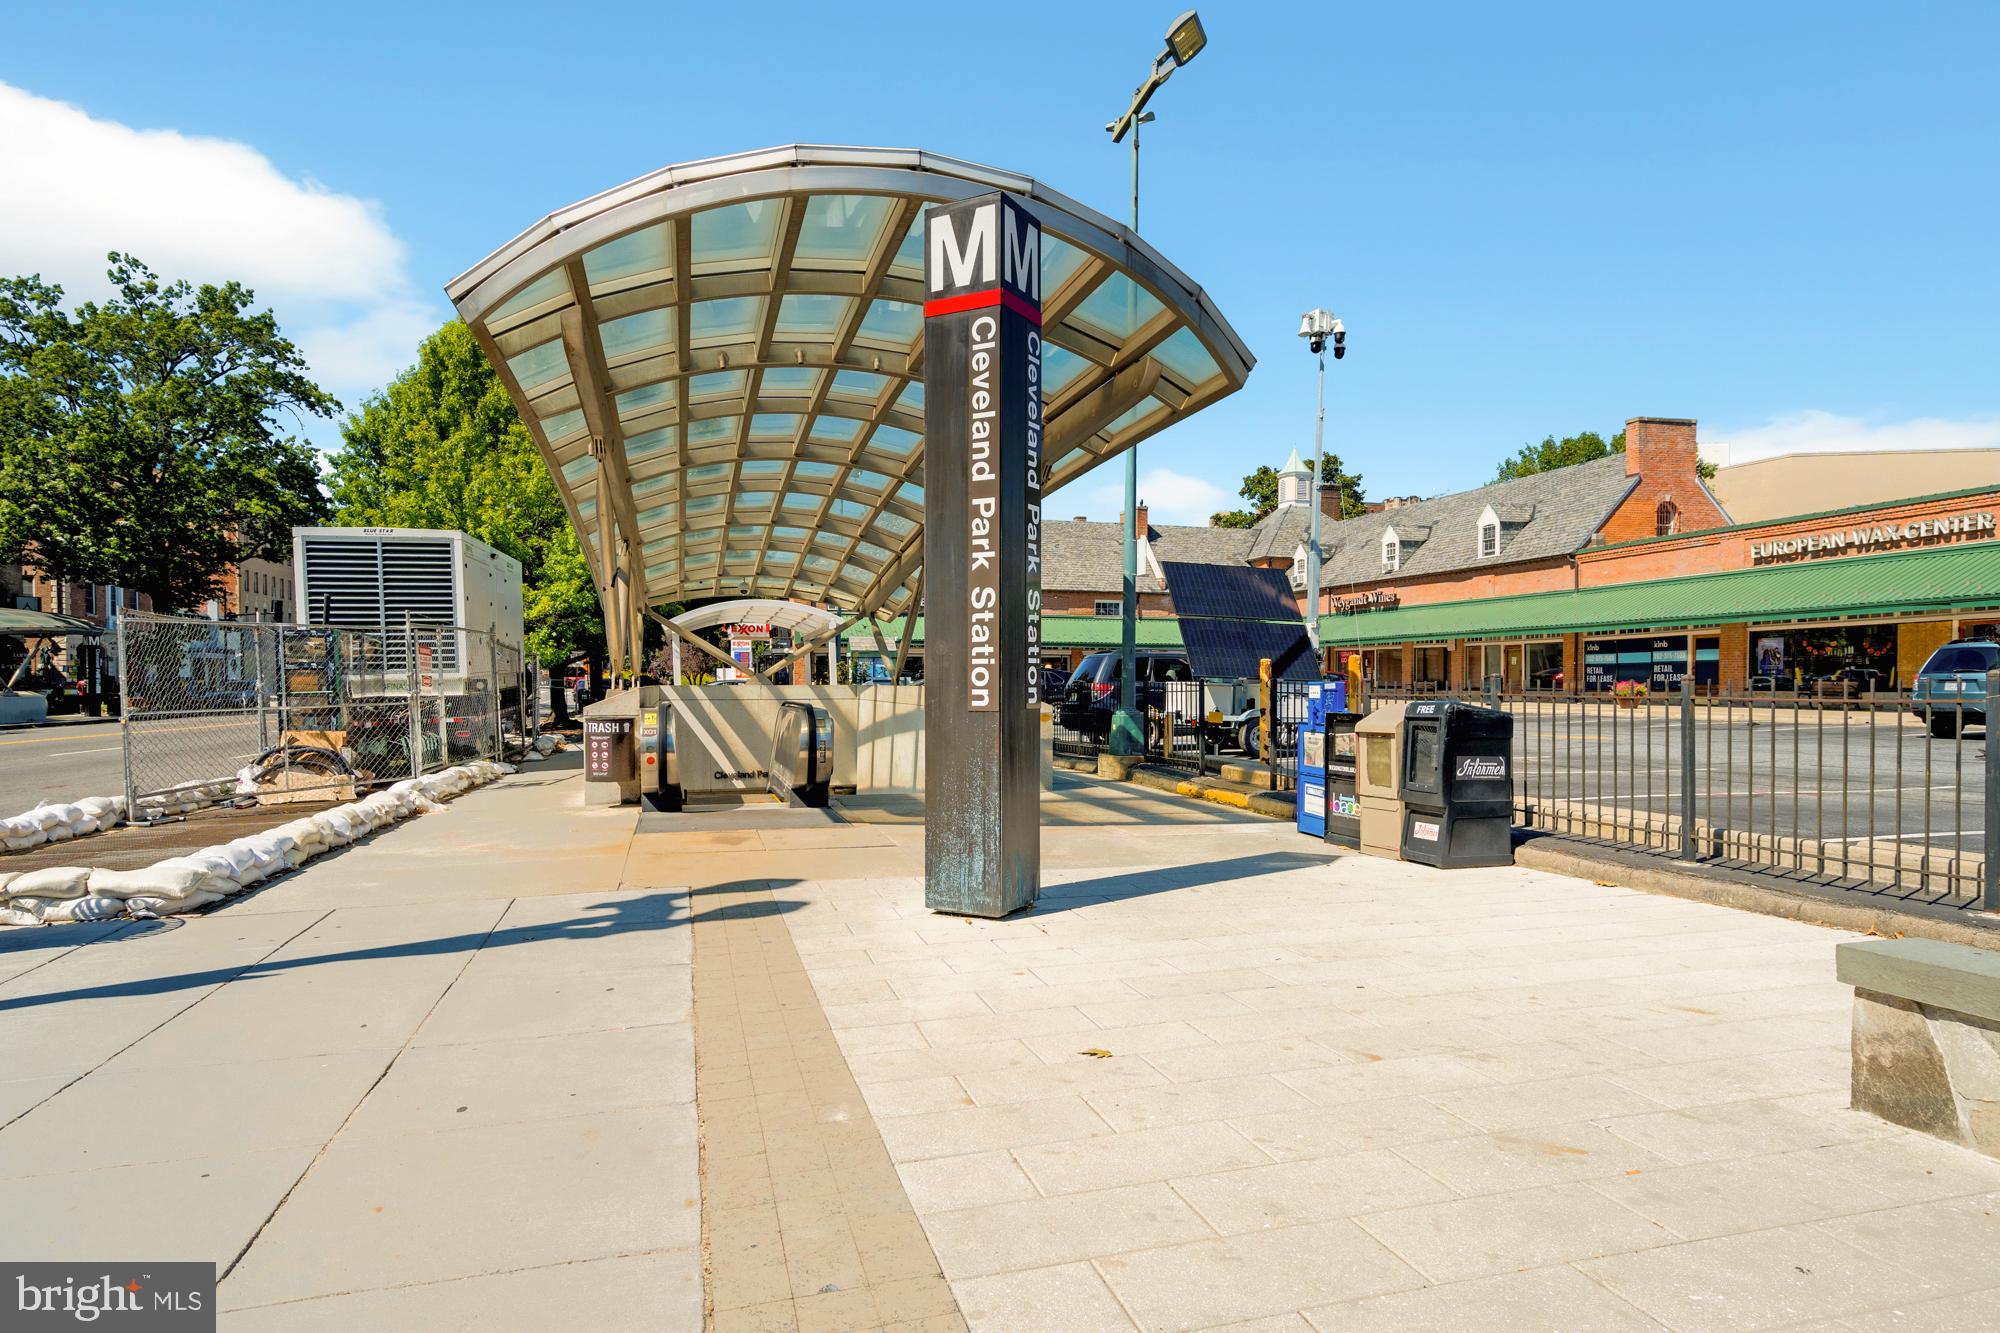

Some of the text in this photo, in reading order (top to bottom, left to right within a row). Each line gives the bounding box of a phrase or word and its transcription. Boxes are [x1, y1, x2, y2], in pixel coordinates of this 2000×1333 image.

[931, 203, 996, 293] M
[1004, 203, 1039, 302] M
[971, 316, 997, 707] Cleveland Park Station
[1028, 330, 1041, 704] Cleveland Park Station
[1750, 511, 1995, 559] EUROPEAN WAX CENTER
[1331, 591, 1396, 610] Weygandt Wines
[731, 623, 764, 635] EXXON
[1586, 667, 1604, 675] RETAIL
[1653, 665, 1673, 673] RETAIL
[1586, 675, 1597, 683] FOR
[1653, 673, 1665, 682] FOR
[1416, 704, 1435, 714] FREE
[588, 722, 619, 733] TRASH
[1457, 756, 1506, 778] Informer
[757, 770, 769, 779] Pa
